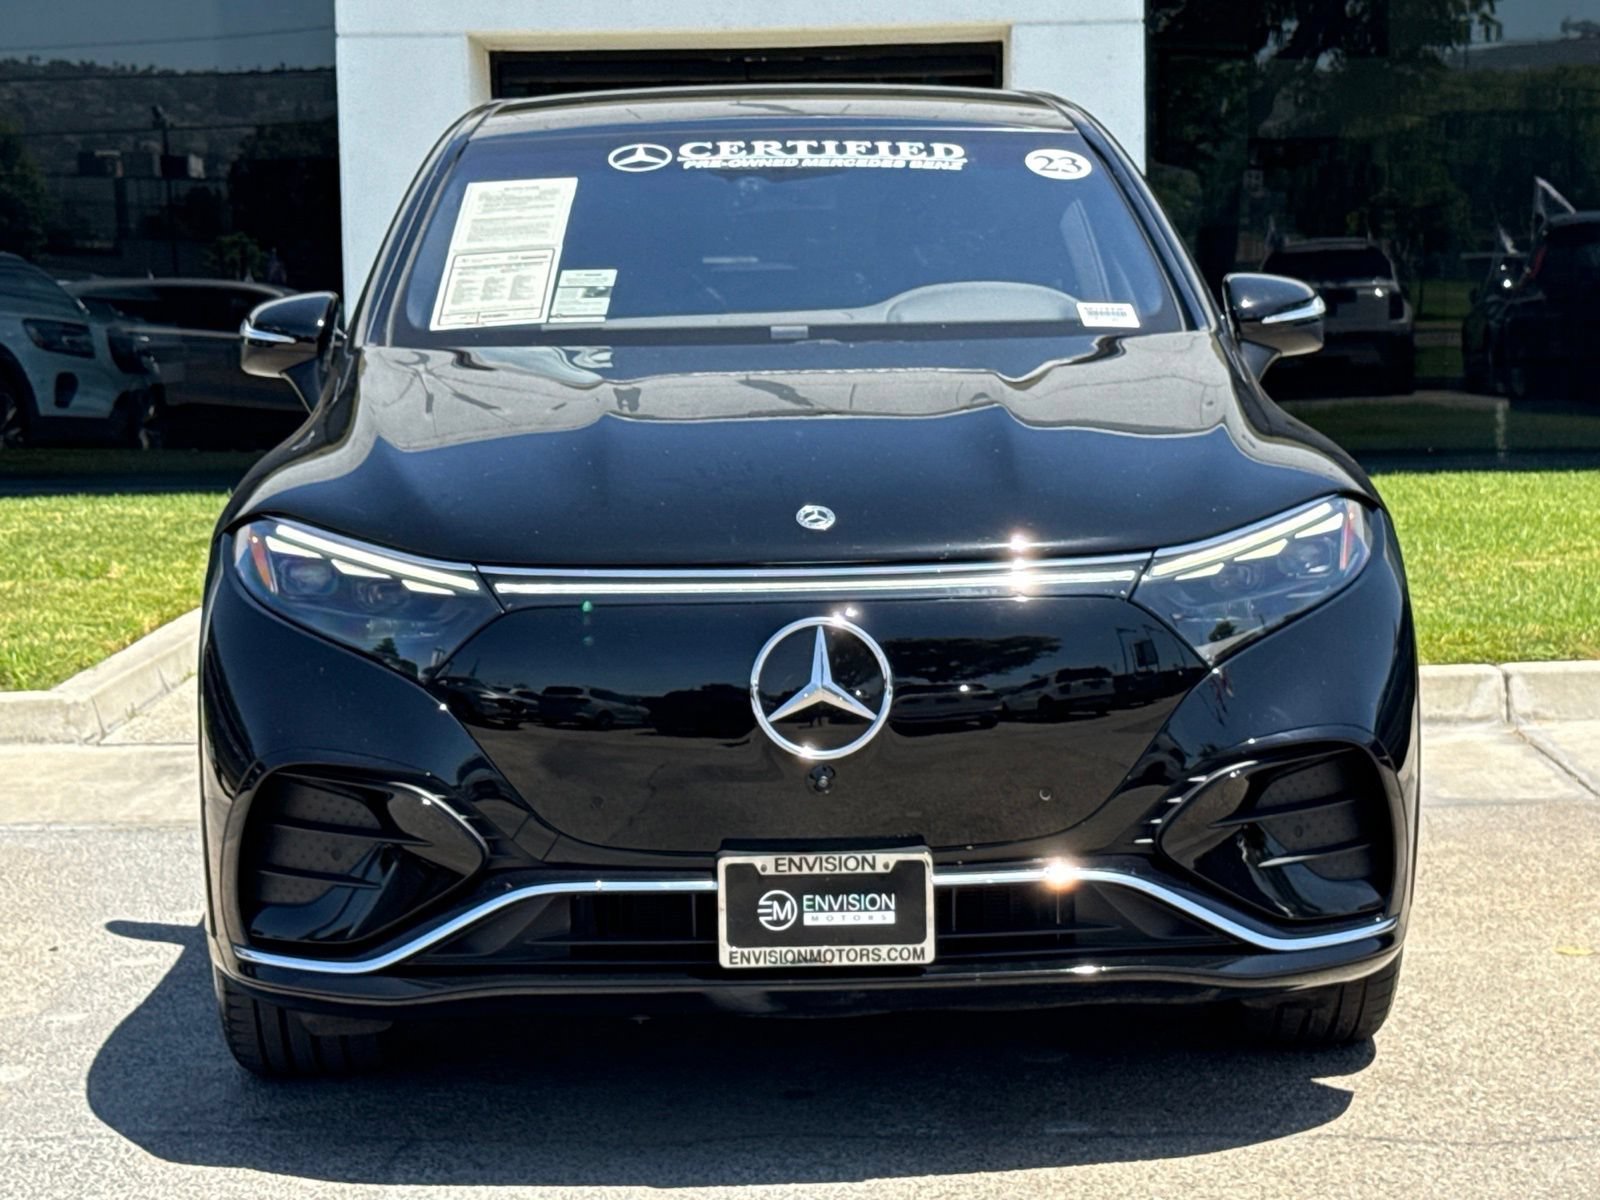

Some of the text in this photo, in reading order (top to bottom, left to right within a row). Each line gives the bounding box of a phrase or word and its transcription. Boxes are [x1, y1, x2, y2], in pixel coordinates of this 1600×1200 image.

[679, 140, 965, 159] CERTIFIED
[683, 159, 799, 169] PRE-OWNED
[909, 160, 962, 170] BENZ
[1033, 155, 1083, 173] 23
[774, 855, 876, 873] ENVISION
[803, 893, 895, 912] ENVISION
[811, 914, 887, 922] MOTORS
[729, 947, 926, 965] ENVISIONMOTORS.COM
